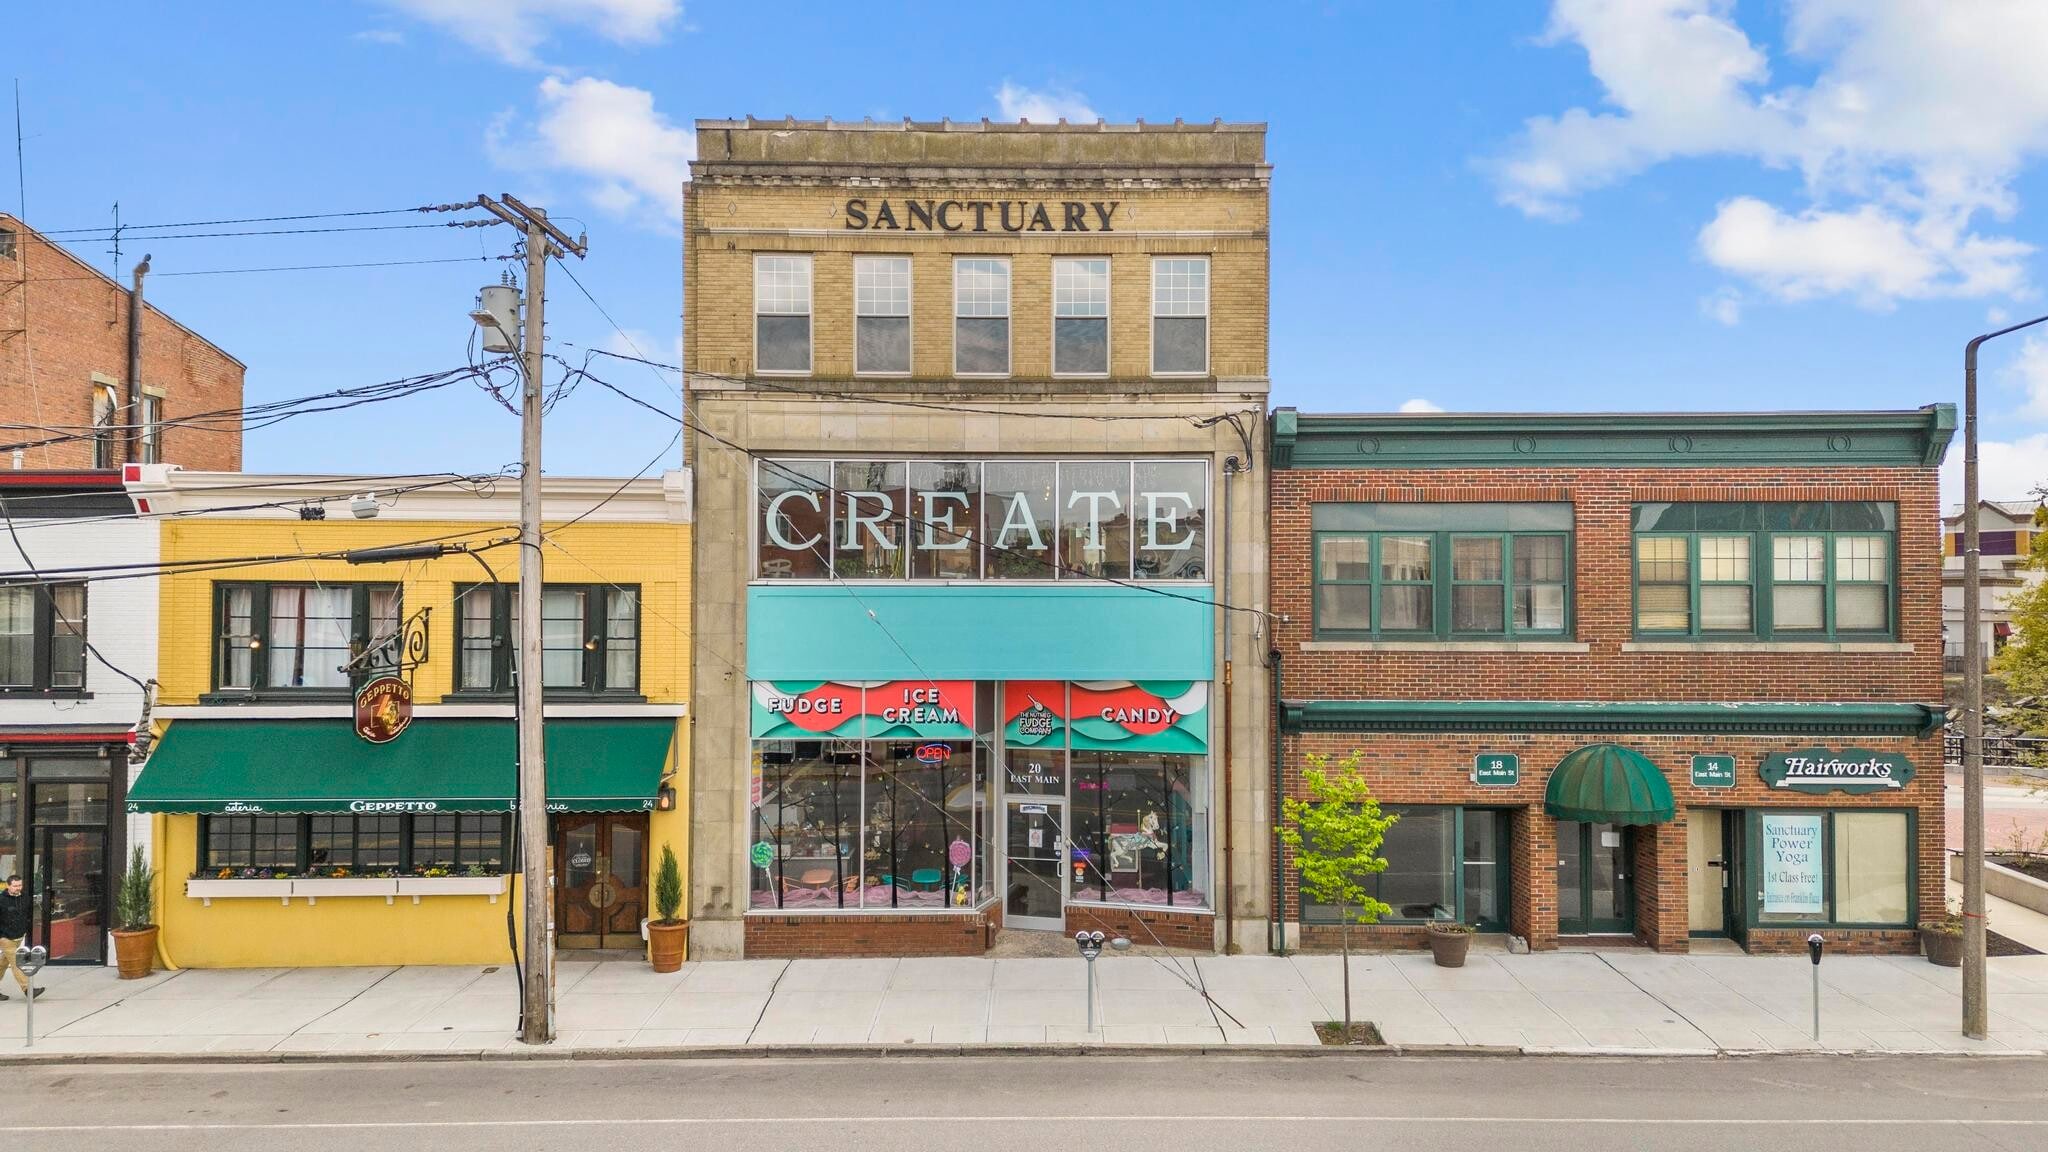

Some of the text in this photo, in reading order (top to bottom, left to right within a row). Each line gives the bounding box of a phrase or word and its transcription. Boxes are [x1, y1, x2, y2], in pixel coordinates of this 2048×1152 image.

[845, 199, 1119, 232] SANCTUARY
[765, 490, 1197, 551] CREATE
[360, 683, 409, 709] GEPPETTO
[903, 688, 939, 704] ICE
[768, 697, 842, 714] FUDGE
[882, 706, 959, 724] CREAM
[1101, 707, 1174, 723] CANDY
[1020, 718, 1052, 728] FUDGE
[1020, 727, 1052, 735] COMPANY
[916, 746, 951, 760] OPEN
[1029, 763, 1041, 774] 20
[1491, 760, 1503, 769] 18
[1708, 762, 1719, 771] 14
[1785, 757, 1893, 778] Hairworks
[1010, 775, 1060, 784] EAST MAIN
[127, 802, 139, 811] 24
[350, 800, 437, 812] GEPPETTO
[643, 800, 653, 808] 24
[1766, 823, 1818, 839] Sanctuary
[1772, 837, 1813, 849] Power
[1776, 851, 1808, 865] Yoga
[1768, 871, 1777, 883] 1st
[1780, 870, 1799, 883] Class
